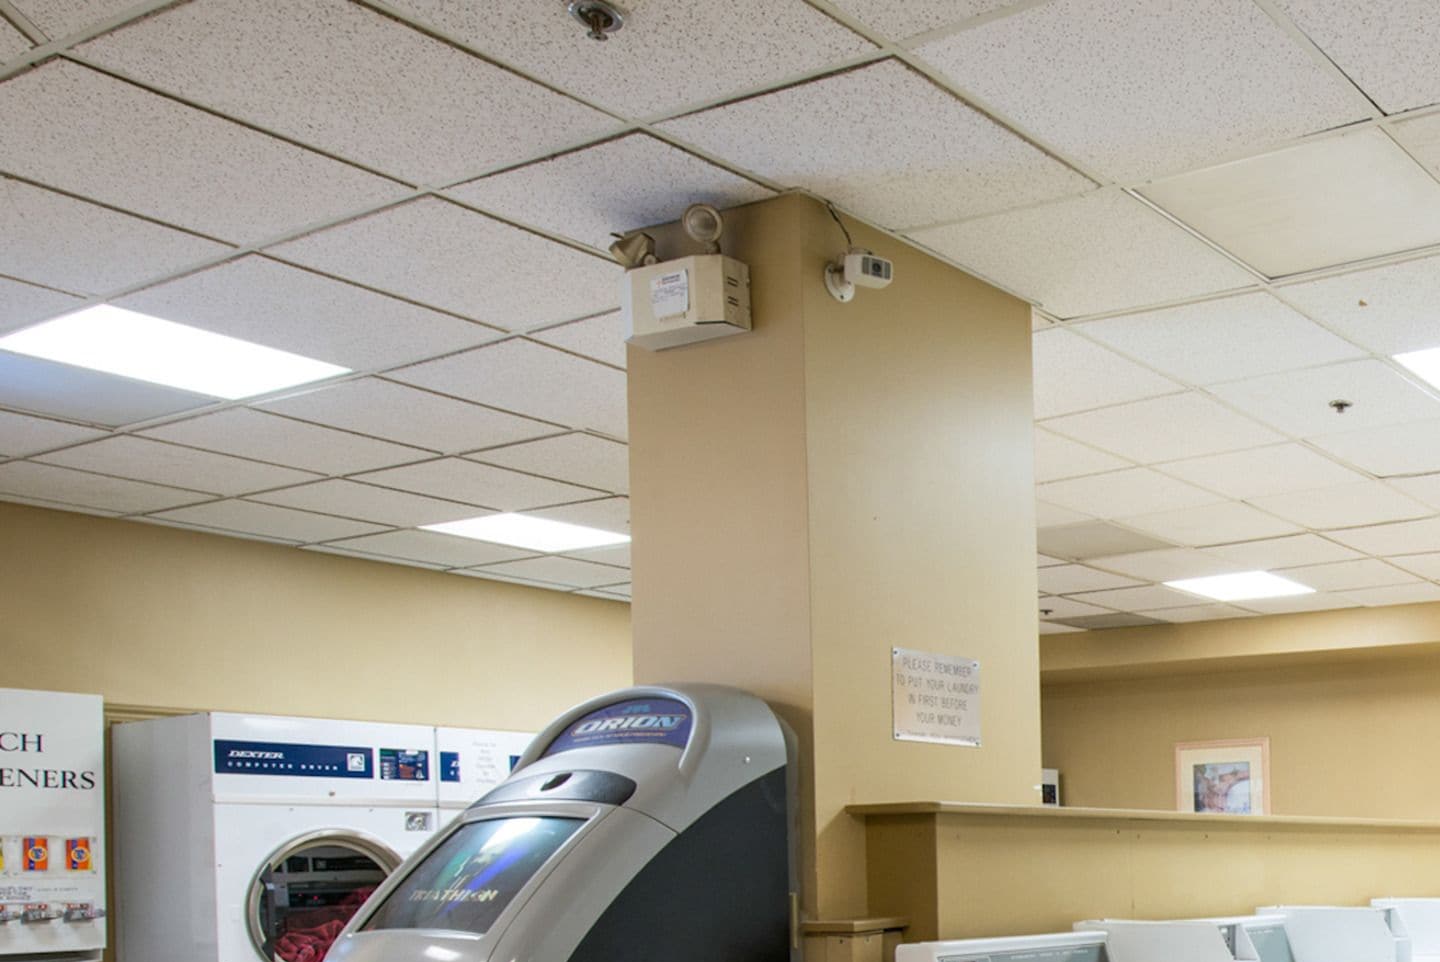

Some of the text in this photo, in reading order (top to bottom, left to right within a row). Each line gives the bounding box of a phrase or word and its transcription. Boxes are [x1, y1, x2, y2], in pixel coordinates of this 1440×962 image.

[903, 657, 971, 678] PLEASE REMEMBER
[896, 672, 979, 696] TO PUT YOUR LAUNDRY
[908, 693, 968, 711] IN FIRST BEFORE
[575, 715, 681, 734] ORION
[916, 711, 962, 727] YOUR MONEY
[228, 750, 285, 760] DEXTER
[227, 761, 294, 769] COMPUTER
[0, 768, 95, 790] ENERS
